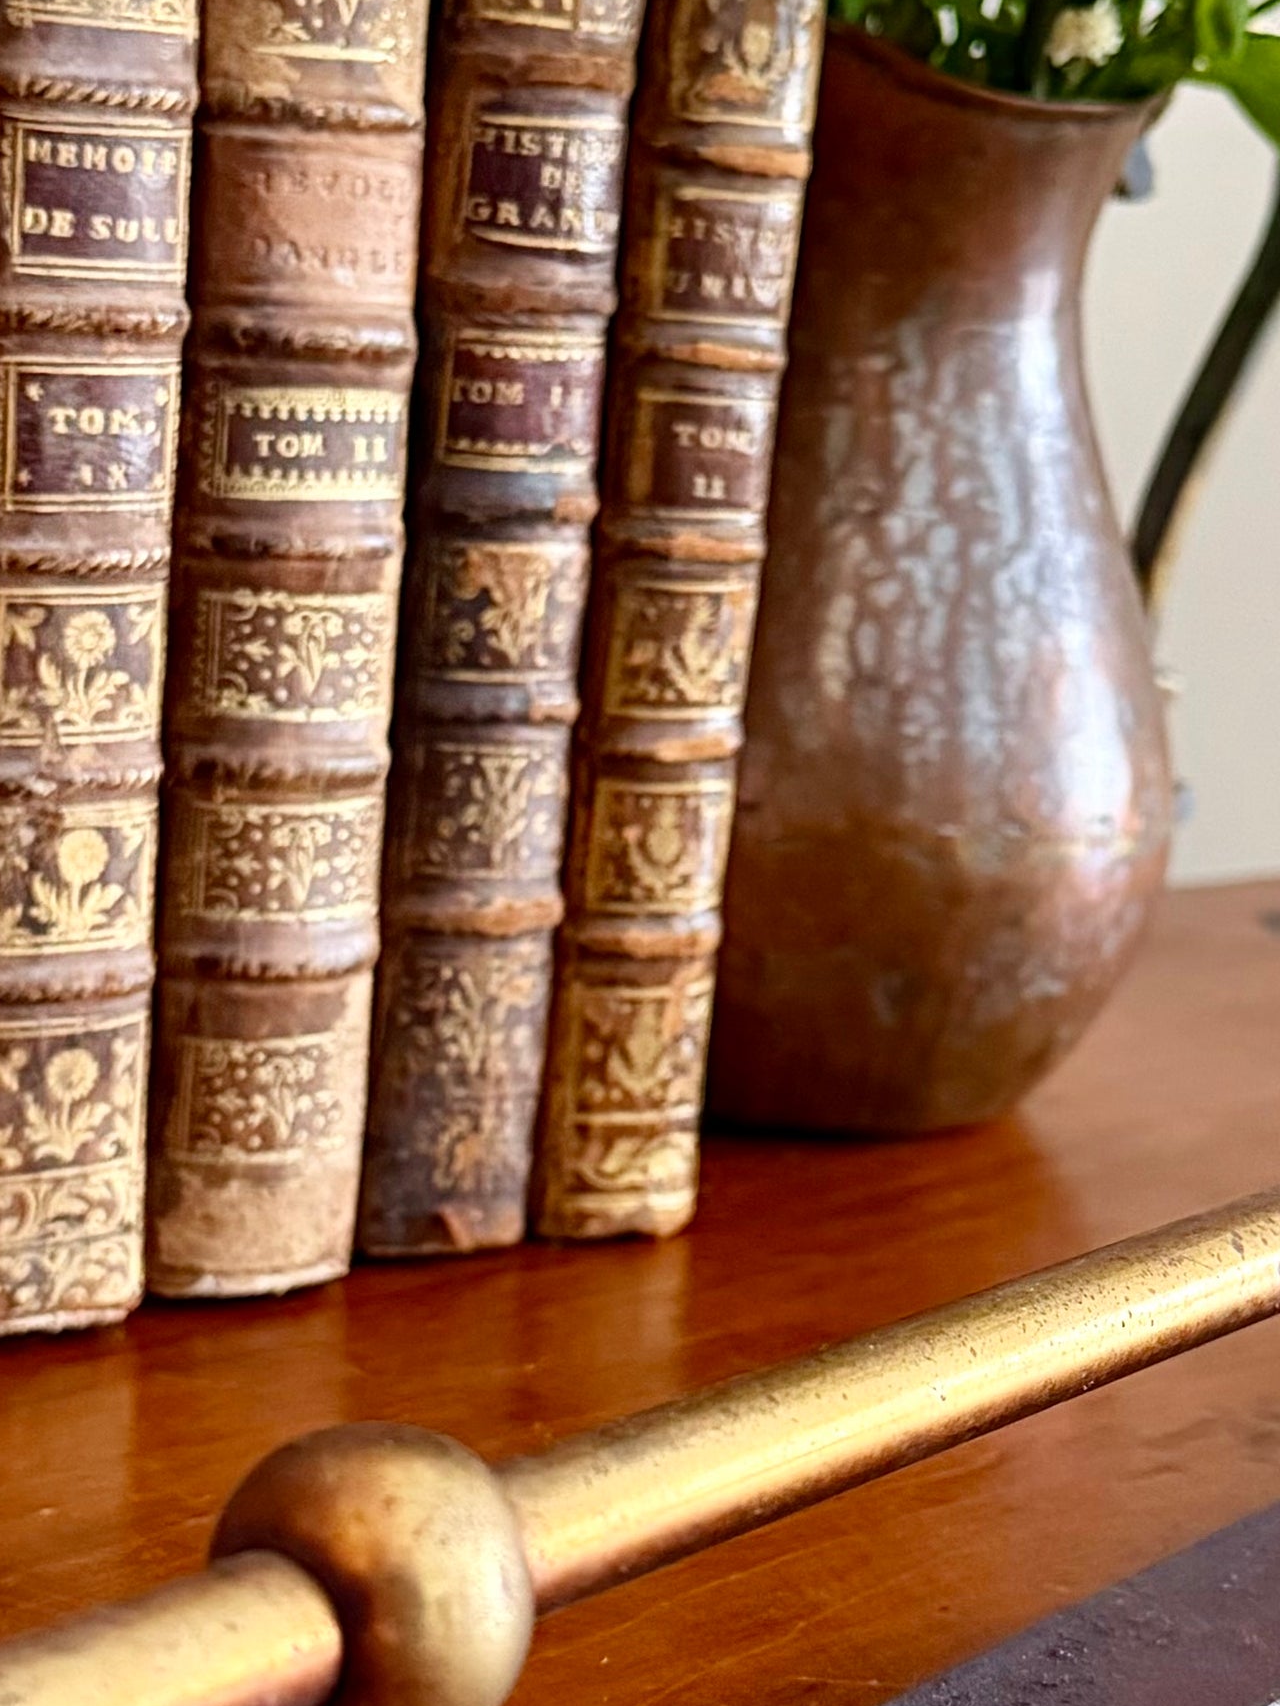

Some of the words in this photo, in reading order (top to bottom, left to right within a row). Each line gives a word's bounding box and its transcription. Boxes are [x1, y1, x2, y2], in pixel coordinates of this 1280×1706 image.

[22, 206, 75, 238] DE
[452, 379, 525, 406] TOM
[253, 431, 325, 458] TOM
[353, 435, 388, 463] II
[672, 423, 759, 456] TOM
[692, 474, 726, 500] II
